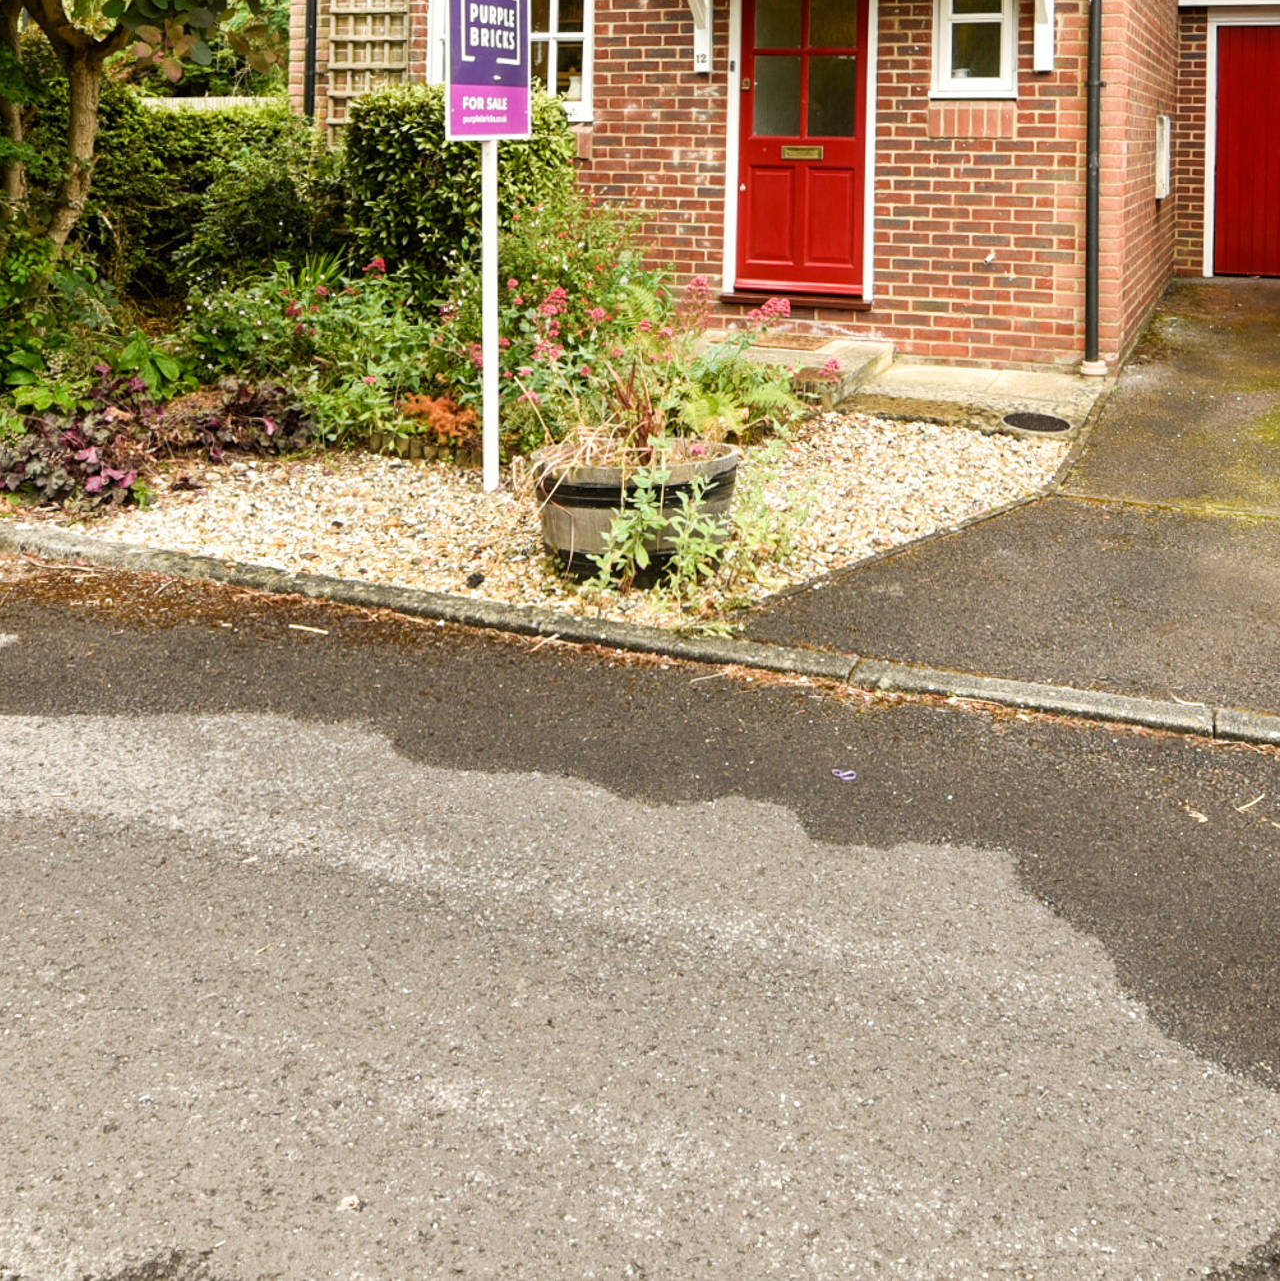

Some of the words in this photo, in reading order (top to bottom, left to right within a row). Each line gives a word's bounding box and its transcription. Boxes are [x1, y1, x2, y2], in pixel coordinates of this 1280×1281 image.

[470, 3, 515, 28] PURPLE
[470, 26, 515, 50] BRICKS
[696, 53, 707, 64] 12
[462, 96, 484, 110] FOR
[486, 97, 508, 110] SALE
